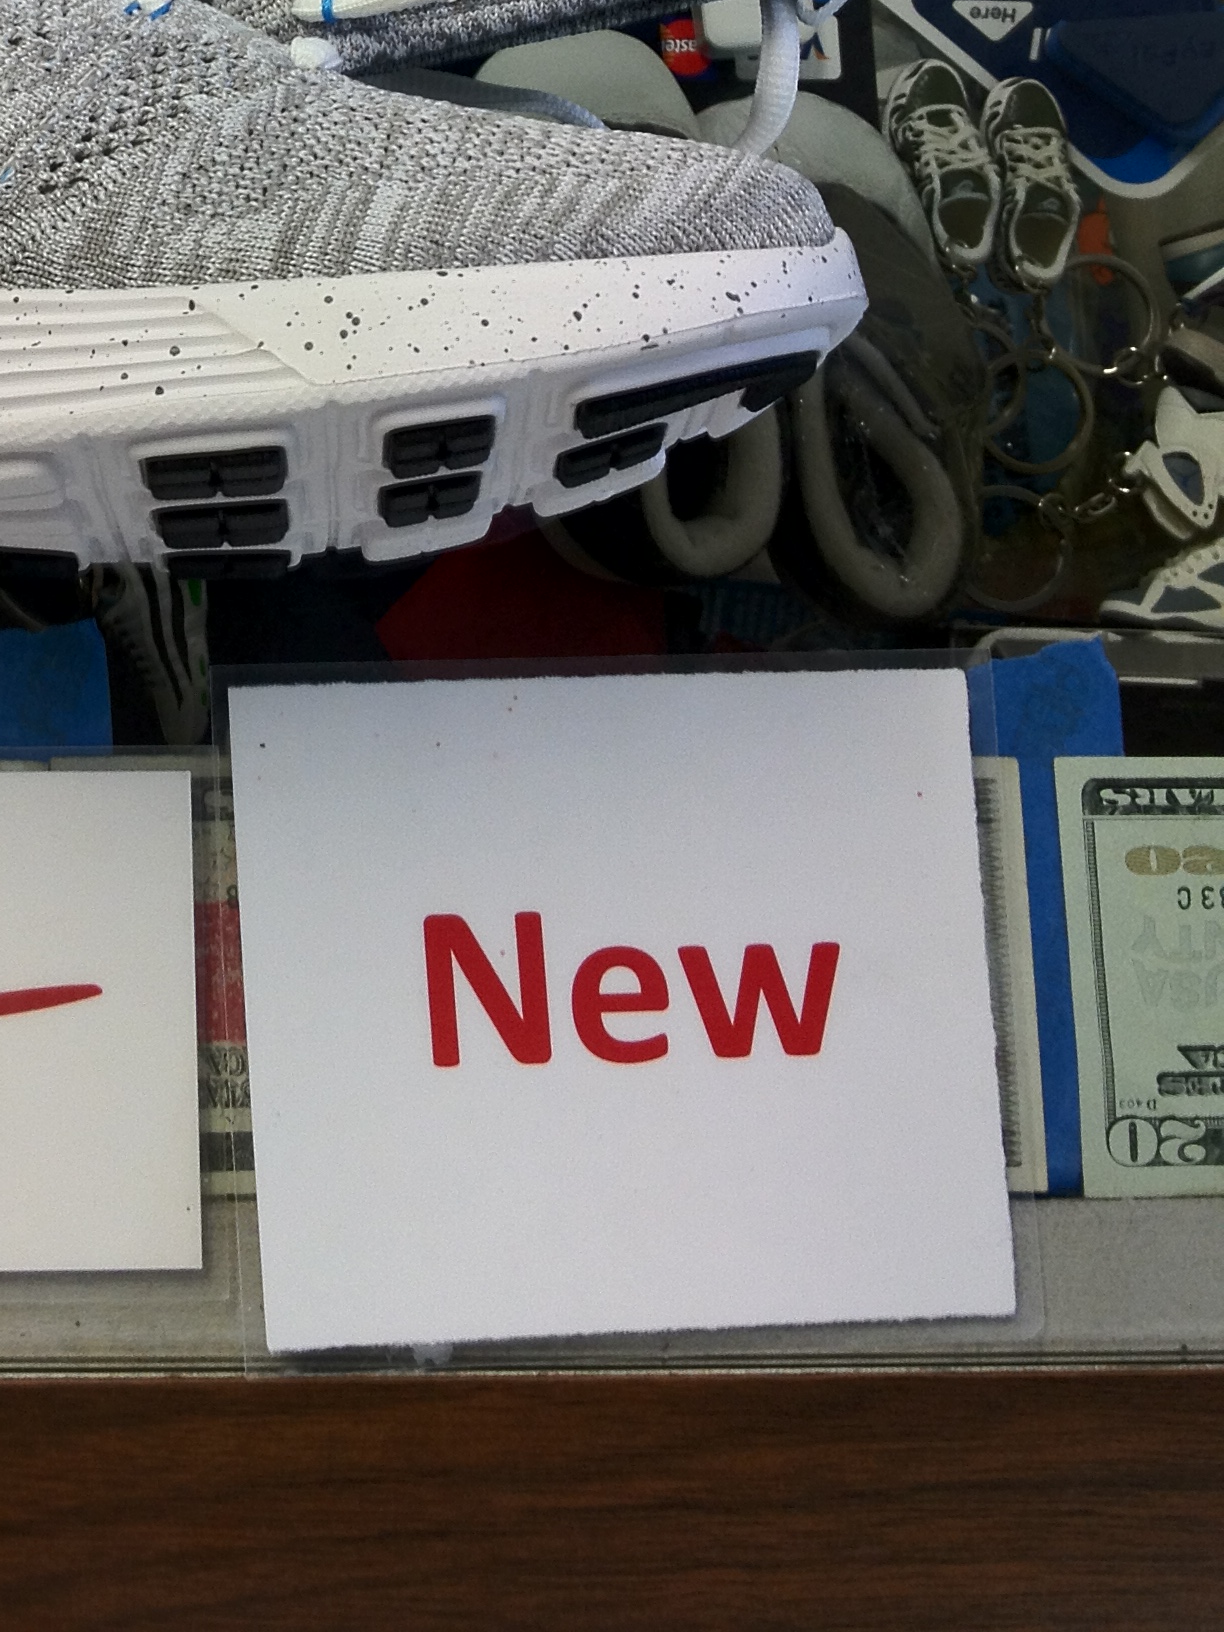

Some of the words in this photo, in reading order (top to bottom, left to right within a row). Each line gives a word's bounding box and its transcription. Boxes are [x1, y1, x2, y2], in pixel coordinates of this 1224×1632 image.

[969, 4, 1017, 22] Here
[422, 911, 841, 1069] New
[1106, 1117, 1206, 1166] 20
